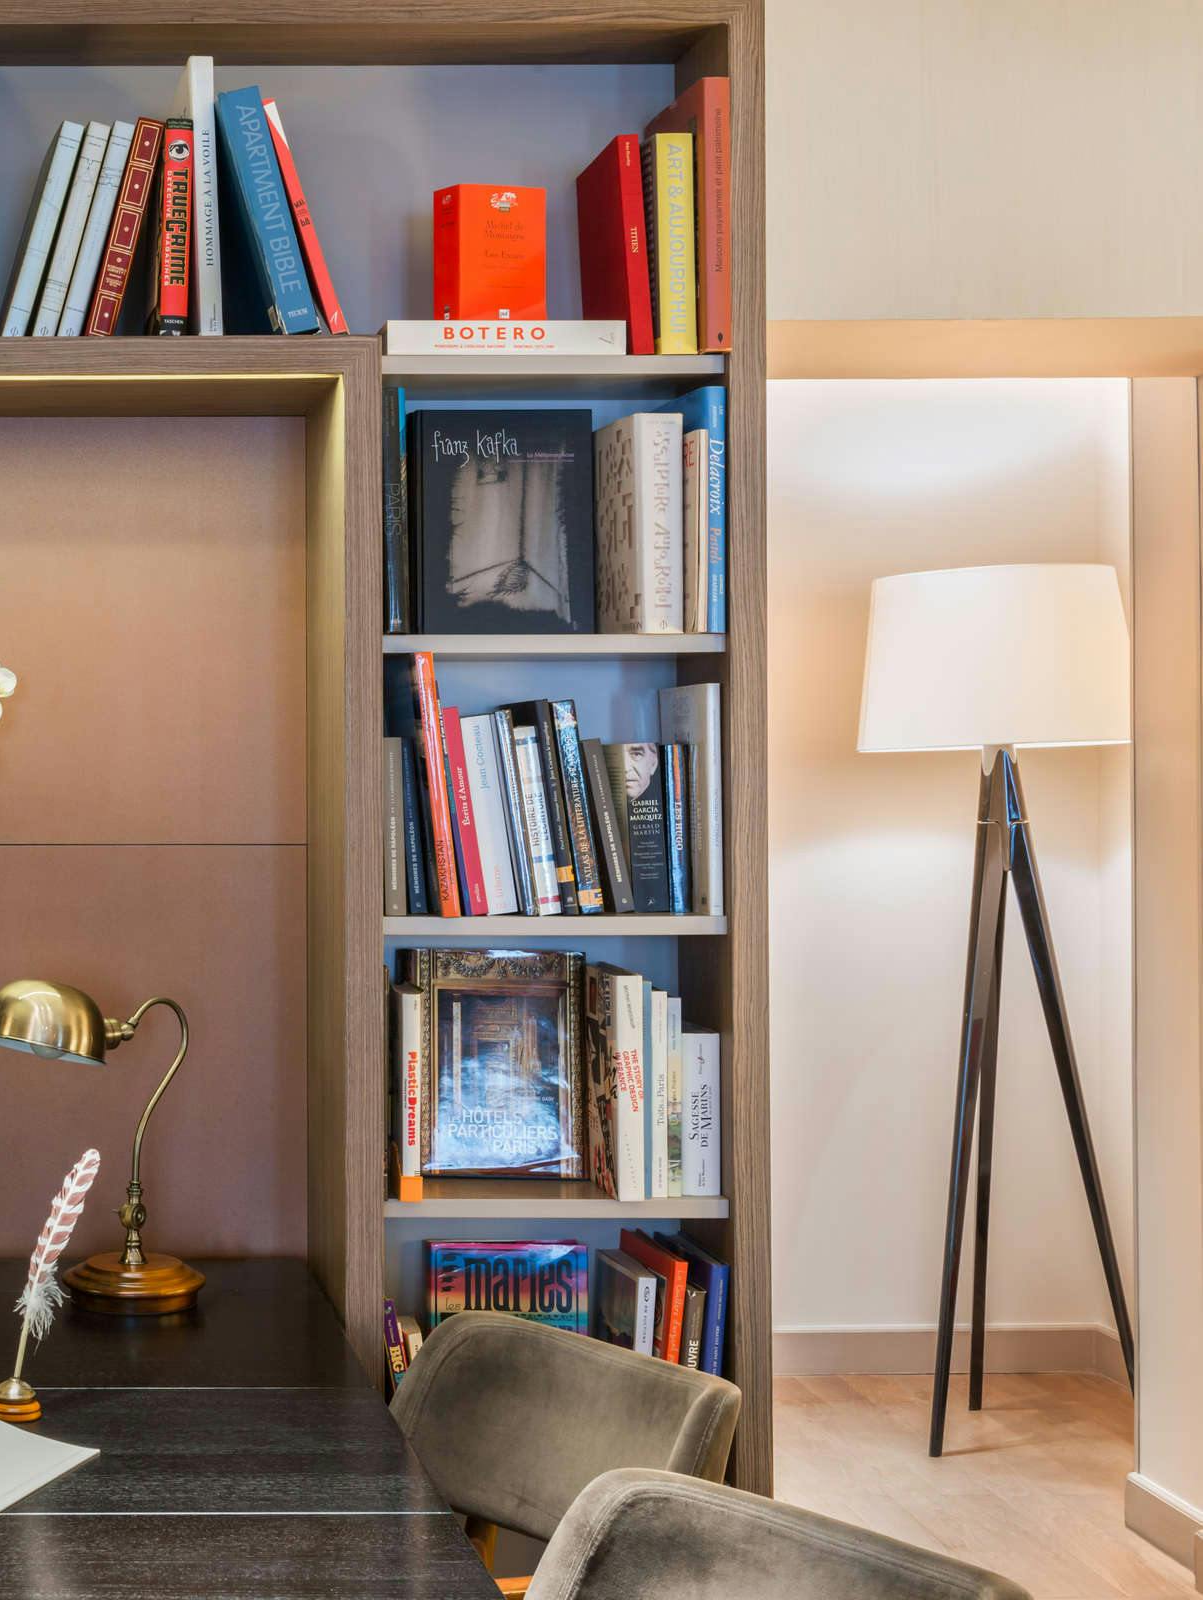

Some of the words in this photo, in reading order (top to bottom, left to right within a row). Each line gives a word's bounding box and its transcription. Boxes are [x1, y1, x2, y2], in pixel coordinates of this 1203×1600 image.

[202, 129, 211, 167] VOILE
[667, 144, 683, 181] ART
[165, 169, 174, 219] DETECTIVE
[203, 170, 212, 185] LA
[668, 186, 684, 198] &
[236, 104, 287, 235] APARTMENT
[269, 235, 302, 295] BIBLE
[204, 201, 214, 267] HOMMAGE
[163, 231, 171, 288] MAGAZINES
[669, 202, 687, 333] AUJOURD'HUI
[443, 327, 546, 340] BOTERO
[431, 430, 470, 468] franz
[709, 438, 725, 515] Delacroix
[386, 482, 402, 536] PARIS
[709, 528, 722, 565] Pastels
[473, 725, 486, 766] Cocteau
[457, 766, 468, 800] d'Amour
[479, 767, 490, 790] Jean
[460, 801, 471, 826] Écrits
[525, 792, 534, 806] DE
[527, 806, 540, 847] HISTOIRE
[435, 839, 450, 902] KAZAKHSTAN
[629, 1048, 638, 1064] THE
[616, 1061, 627, 1092] FRANCE
[622, 1050, 634, 1084] GRAPHIC
[628, 1084, 639, 1113] DESIGN
[632, 1065, 642, 1089] STORY
[656, 1073, 665, 1098] Paris
[462, 1106, 522, 1125] HÔTELS
[688, 1091, 699, 1141] SAGESSE
[700, 1083, 712, 1131] MARINS
[448, 1123, 558, 1140] PARTICULIERS
[700, 1132, 709, 1148] DE
[446, 1297, 461, 1311] les
